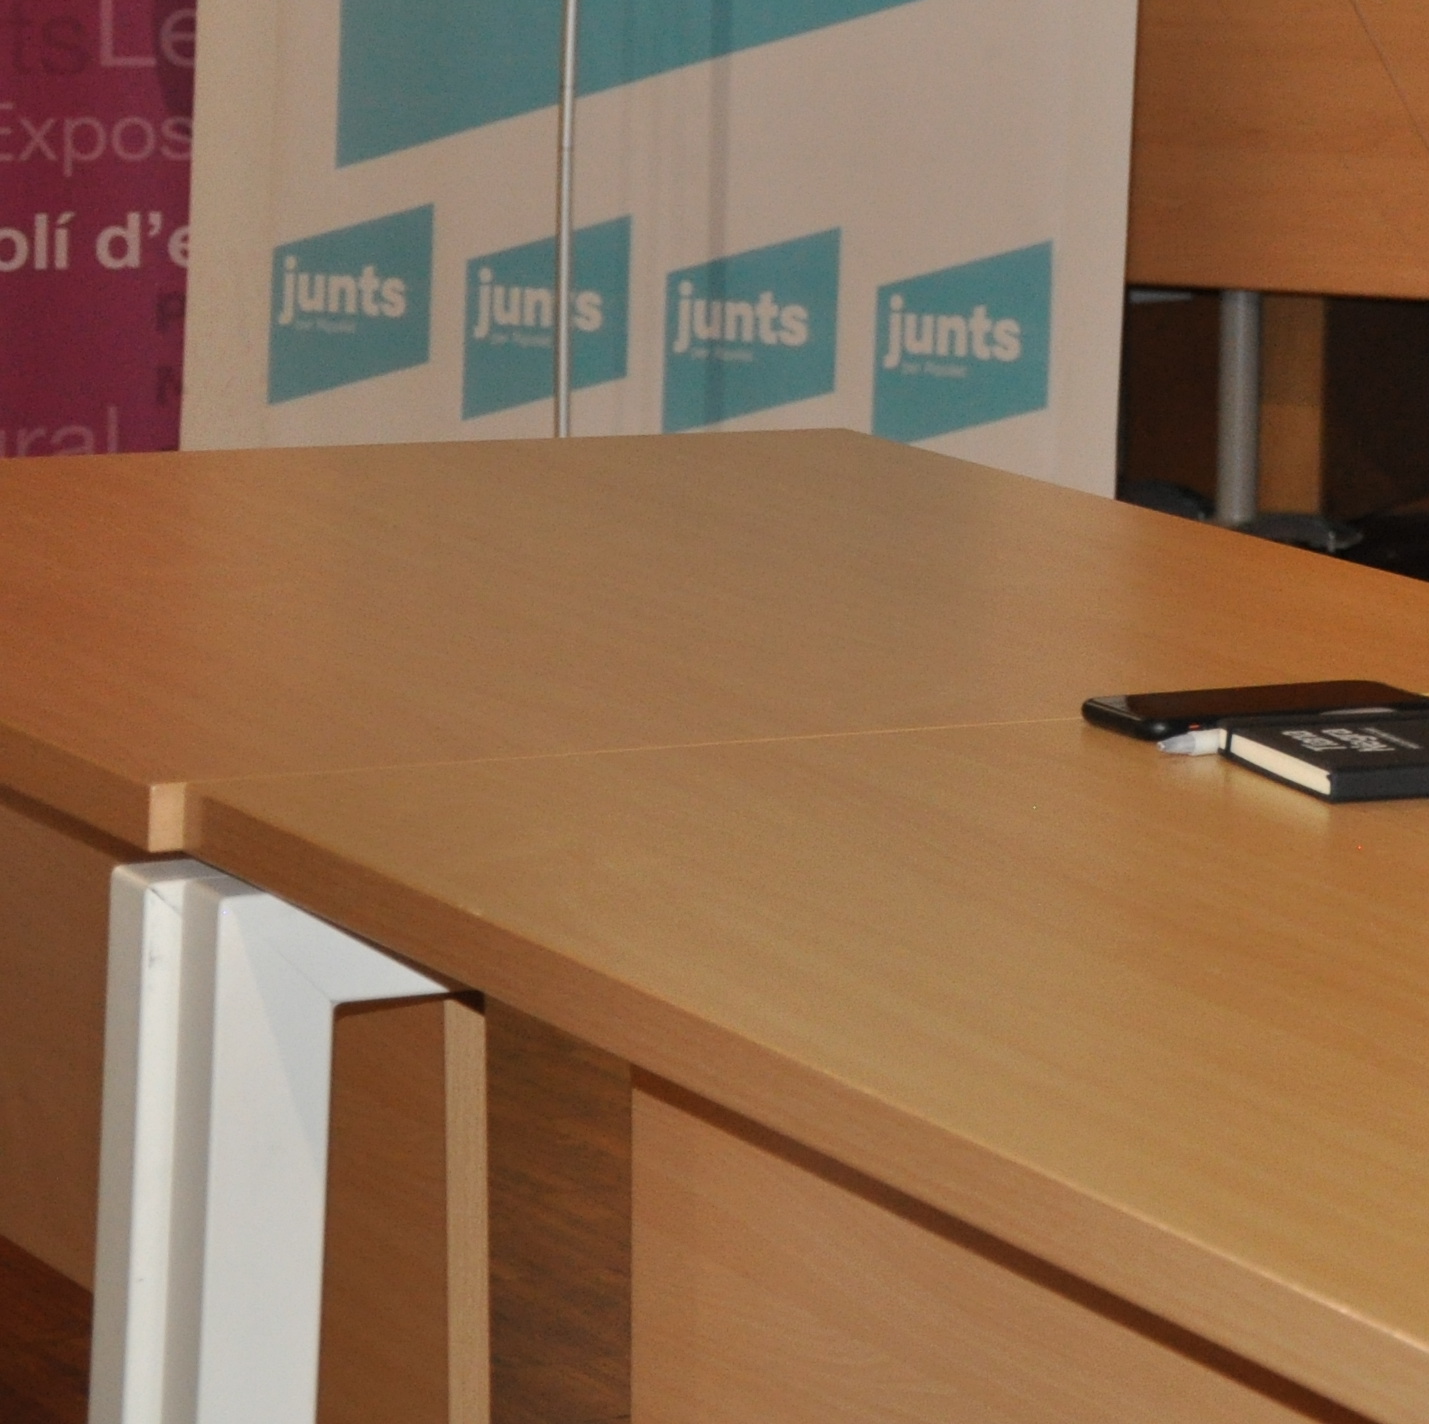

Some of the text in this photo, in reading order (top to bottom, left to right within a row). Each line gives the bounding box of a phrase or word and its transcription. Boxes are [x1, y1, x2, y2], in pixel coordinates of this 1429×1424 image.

[279, 255, 407, 325] junts
[474, 267, 603, 339] juns
[673, 281, 809, 354] junts
[883, 294, 1022, 369] junts
